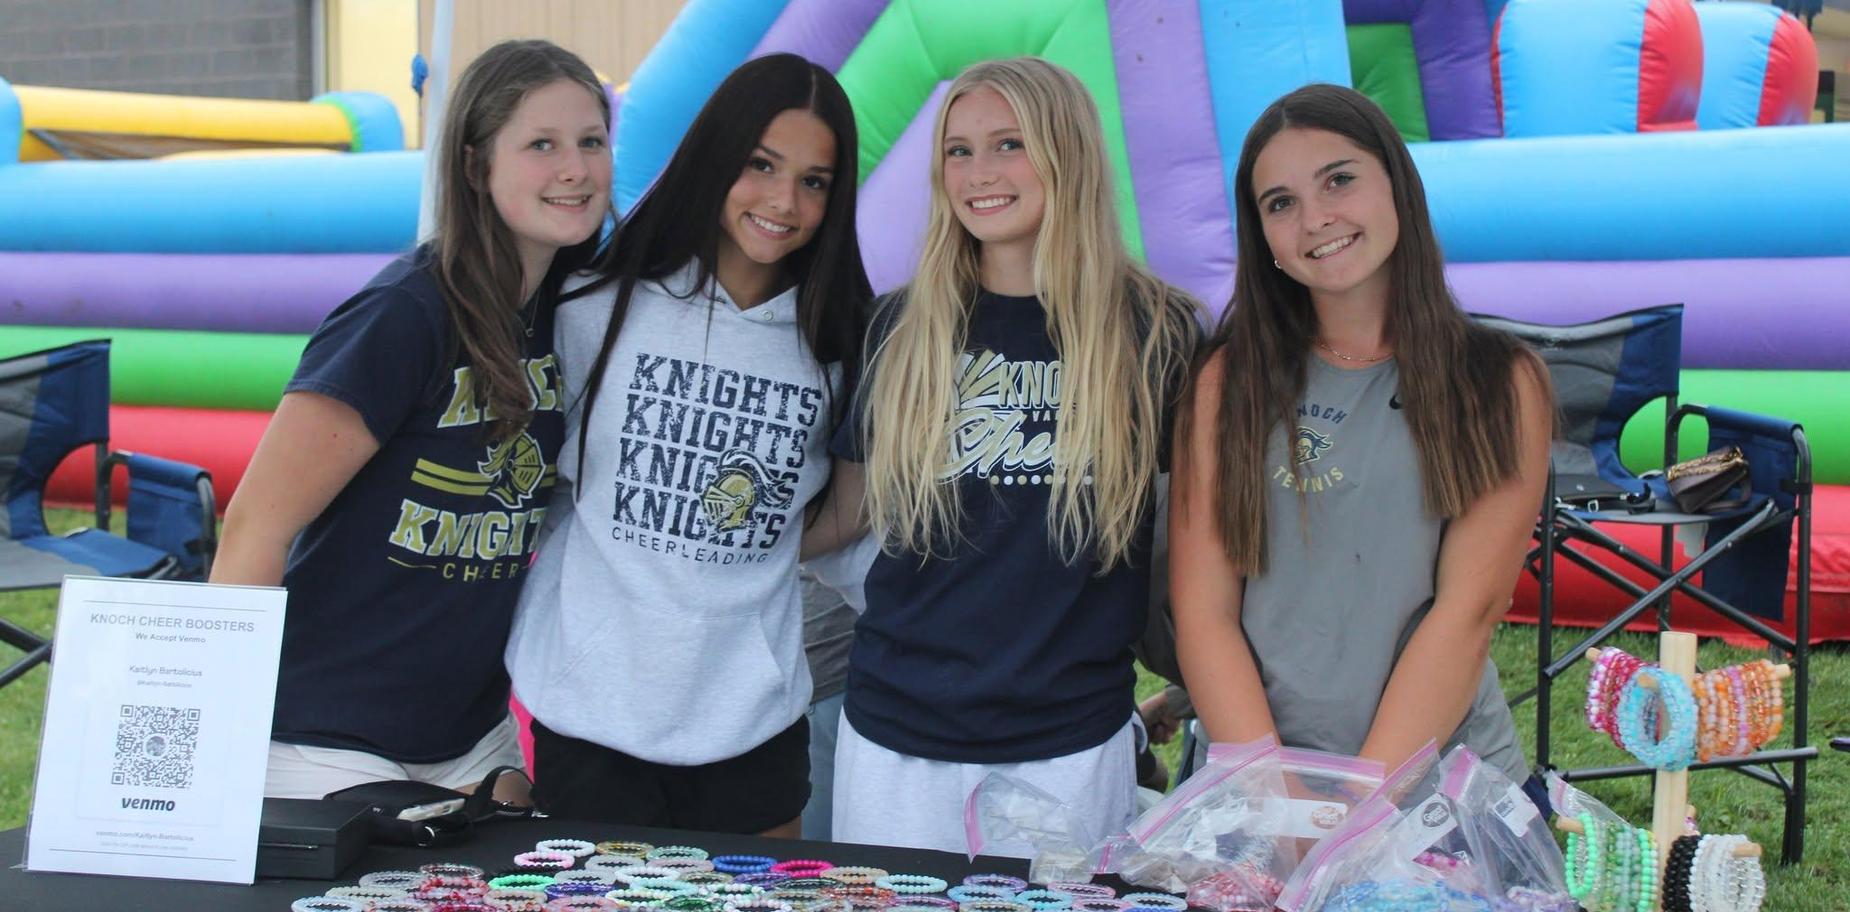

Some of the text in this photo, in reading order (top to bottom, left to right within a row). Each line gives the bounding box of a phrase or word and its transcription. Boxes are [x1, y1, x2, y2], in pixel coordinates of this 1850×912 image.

[628, 352, 823, 427] KNIGHTS
[999, 359, 1062, 410] KNO
[621, 392, 809, 469] KNIGHTS
[1297, 403, 1347, 424] NOCH
[935, 407, 1057, 485] Che
[616, 436, 800, 511] KNIGS
[611, 526, 769, 566] CHEERLEADING
[442, 561, 519, 583] CHER
[90, 612, 255, 633] KNOCH CHEER BOOSTERS
[135, 631, 206, 644] We Accept Venmo
[121, 796, 176, 812] venmo
